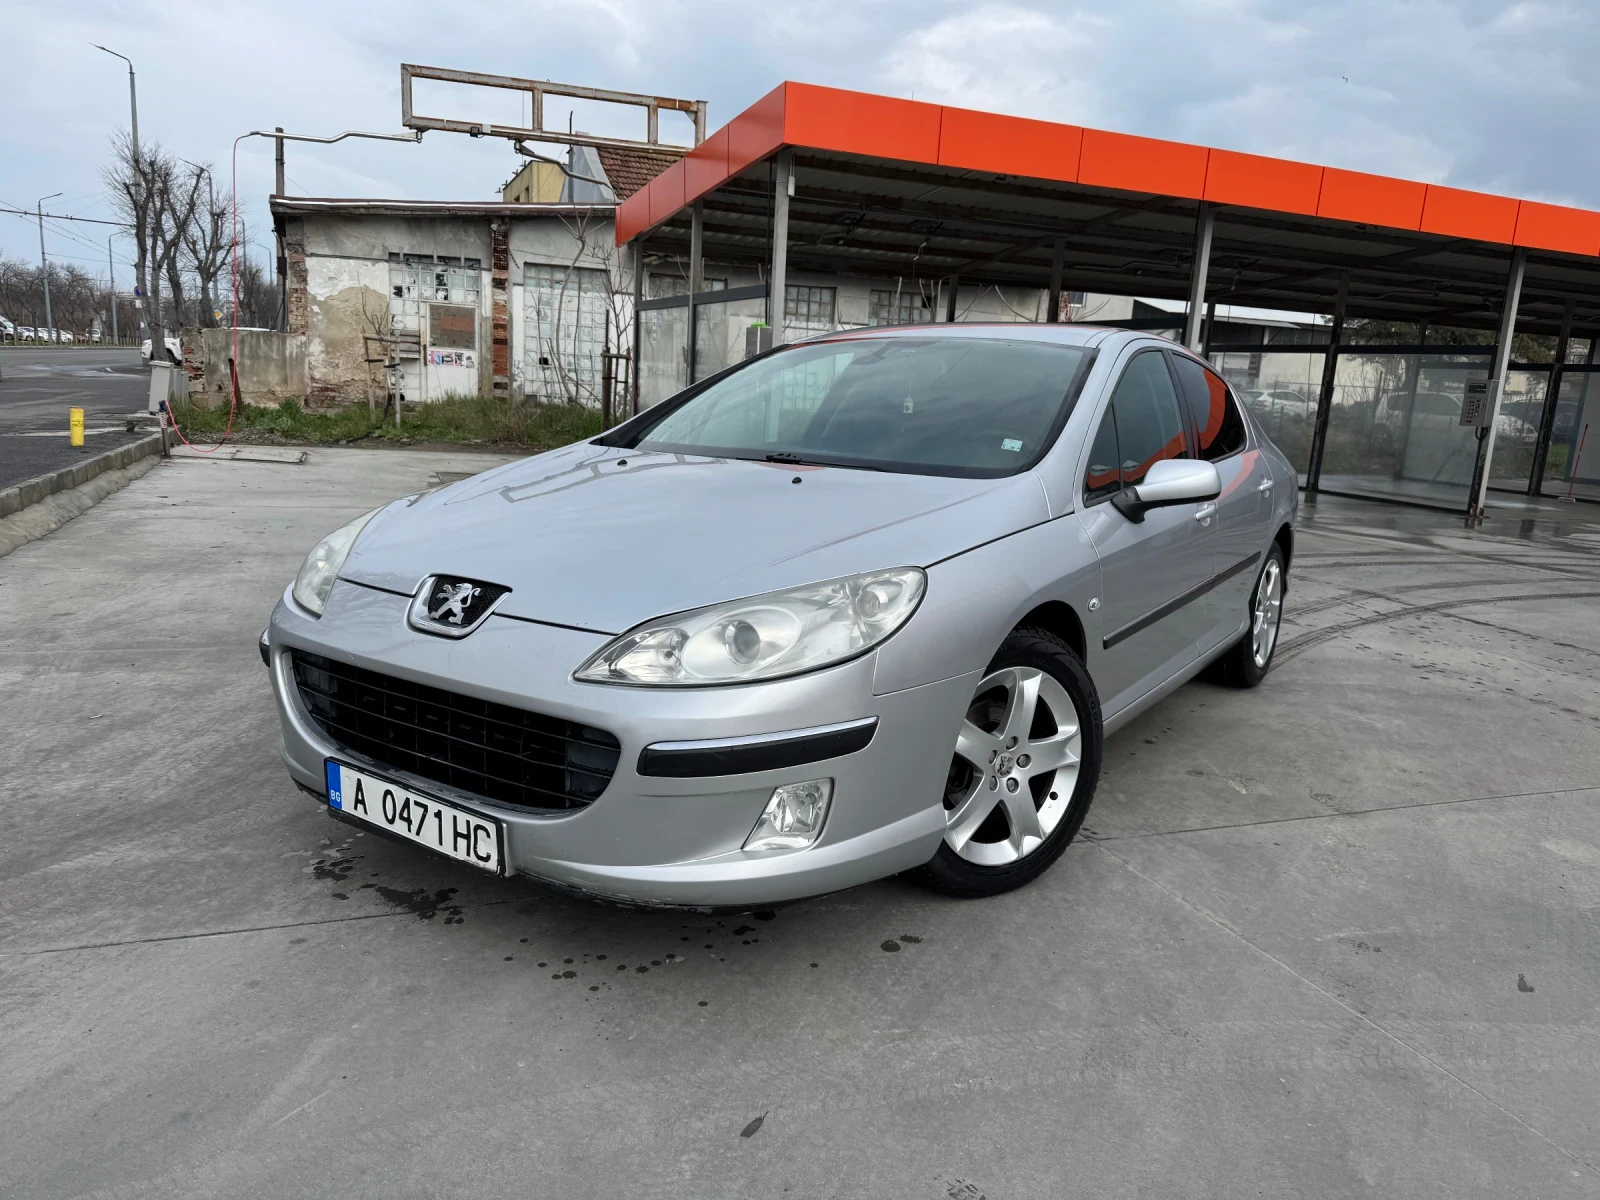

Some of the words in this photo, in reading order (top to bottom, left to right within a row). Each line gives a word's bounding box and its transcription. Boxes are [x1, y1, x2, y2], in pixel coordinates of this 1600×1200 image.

[330, 789, 341, 803] BG
[353, 778, 368, 816] A
[382, 788, 443, 847] 0471
[452, 814, 492, 863] HC
